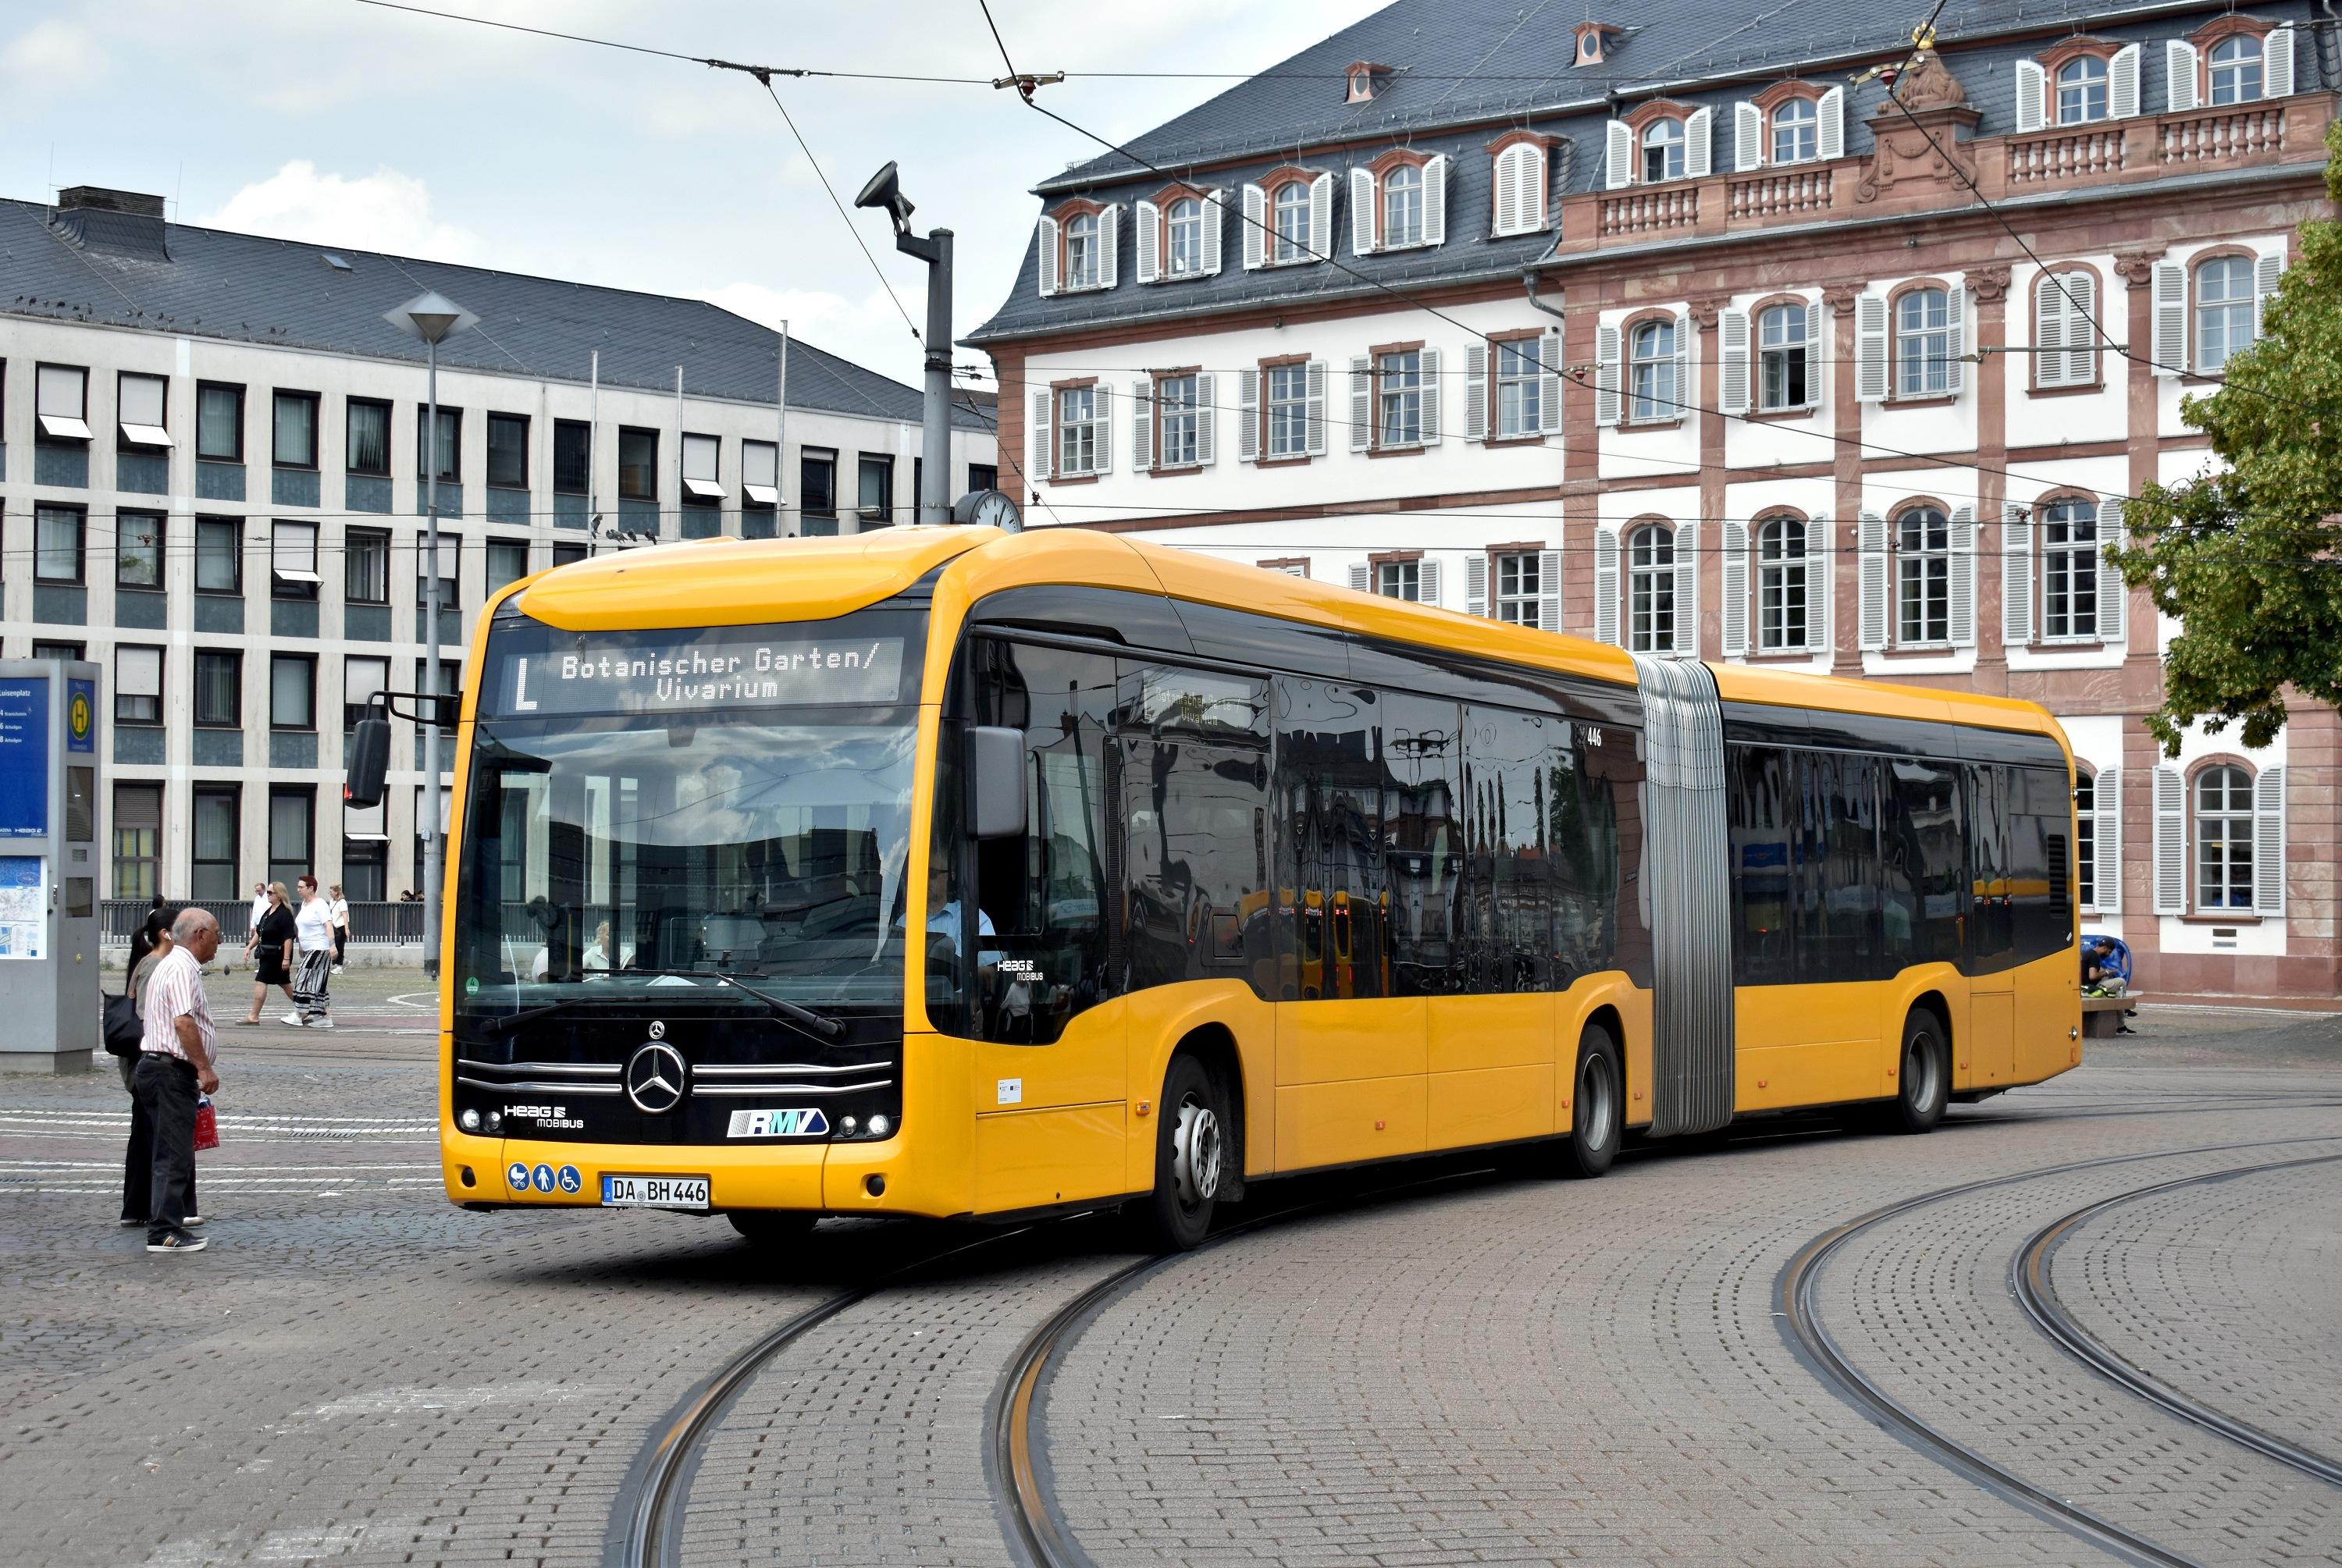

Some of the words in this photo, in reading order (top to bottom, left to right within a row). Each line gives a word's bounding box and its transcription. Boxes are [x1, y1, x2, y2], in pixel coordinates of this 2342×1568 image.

[562, 651, 740, 679] Botanischer
[755, 642, 880, 671] Garten/
[515, 658, 537, 710] L
[657, 675, 778, 701] Vivarium
[1587, 727, 1602, 746] 446
[1016, 972, 1044, 981] MOBIBUS
[536, 1118, 584, 1129] MOBIBUS
[749, 1111, 818, 1134] RMV
[613, 1180, 636, 1200] DA
[647, 1181, 670, 1201] BH
[674, 1182, 706, 1202] 446
